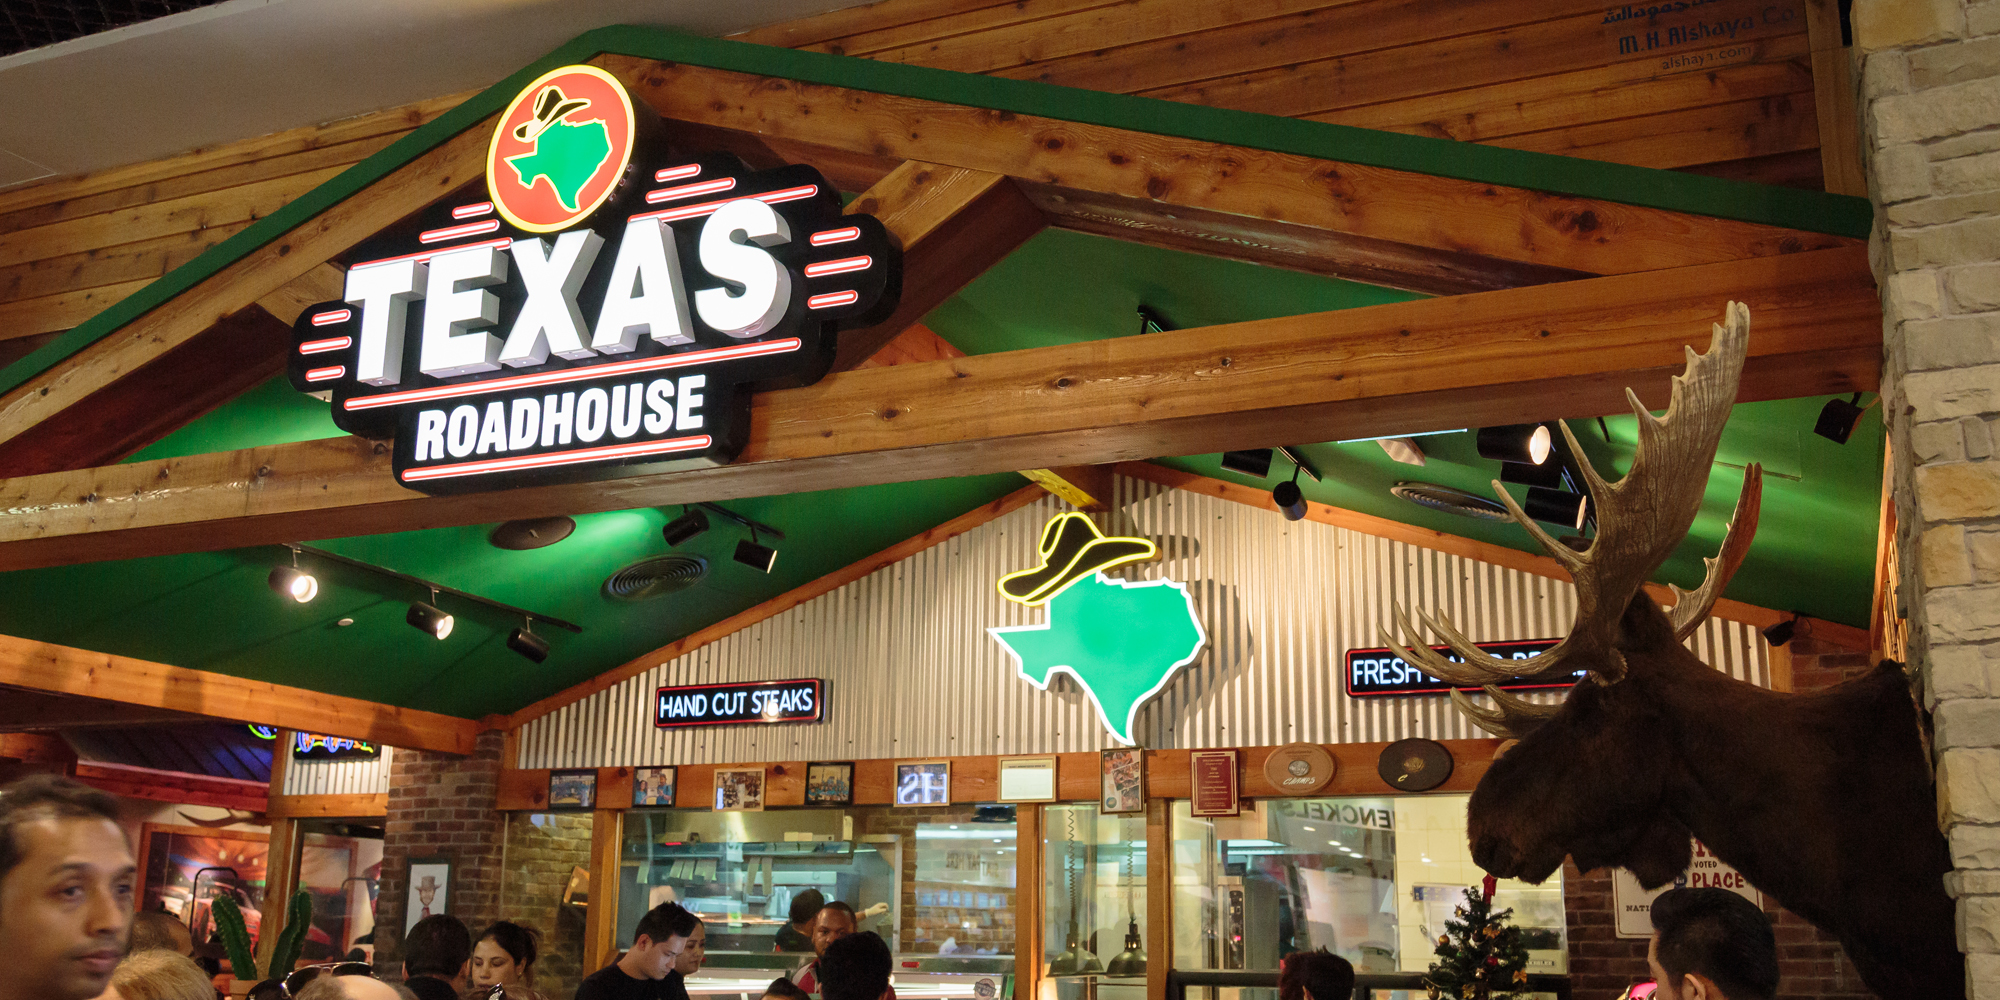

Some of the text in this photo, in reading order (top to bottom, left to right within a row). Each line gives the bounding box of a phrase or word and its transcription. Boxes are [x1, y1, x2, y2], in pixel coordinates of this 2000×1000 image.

[1669, 15, 1755, 46] Alshaya
[345, 199, 791, 386] TEXAS
[415, 375, 706, 461] ROADHOUSE
[1352, 658, 1422, 685] FRESH
[659, 688, 813, 718] HAND CUT STEAKS
[1694, 860, 1717, 868] VOTED
[1692, 872, 1744, 888] PLACE
